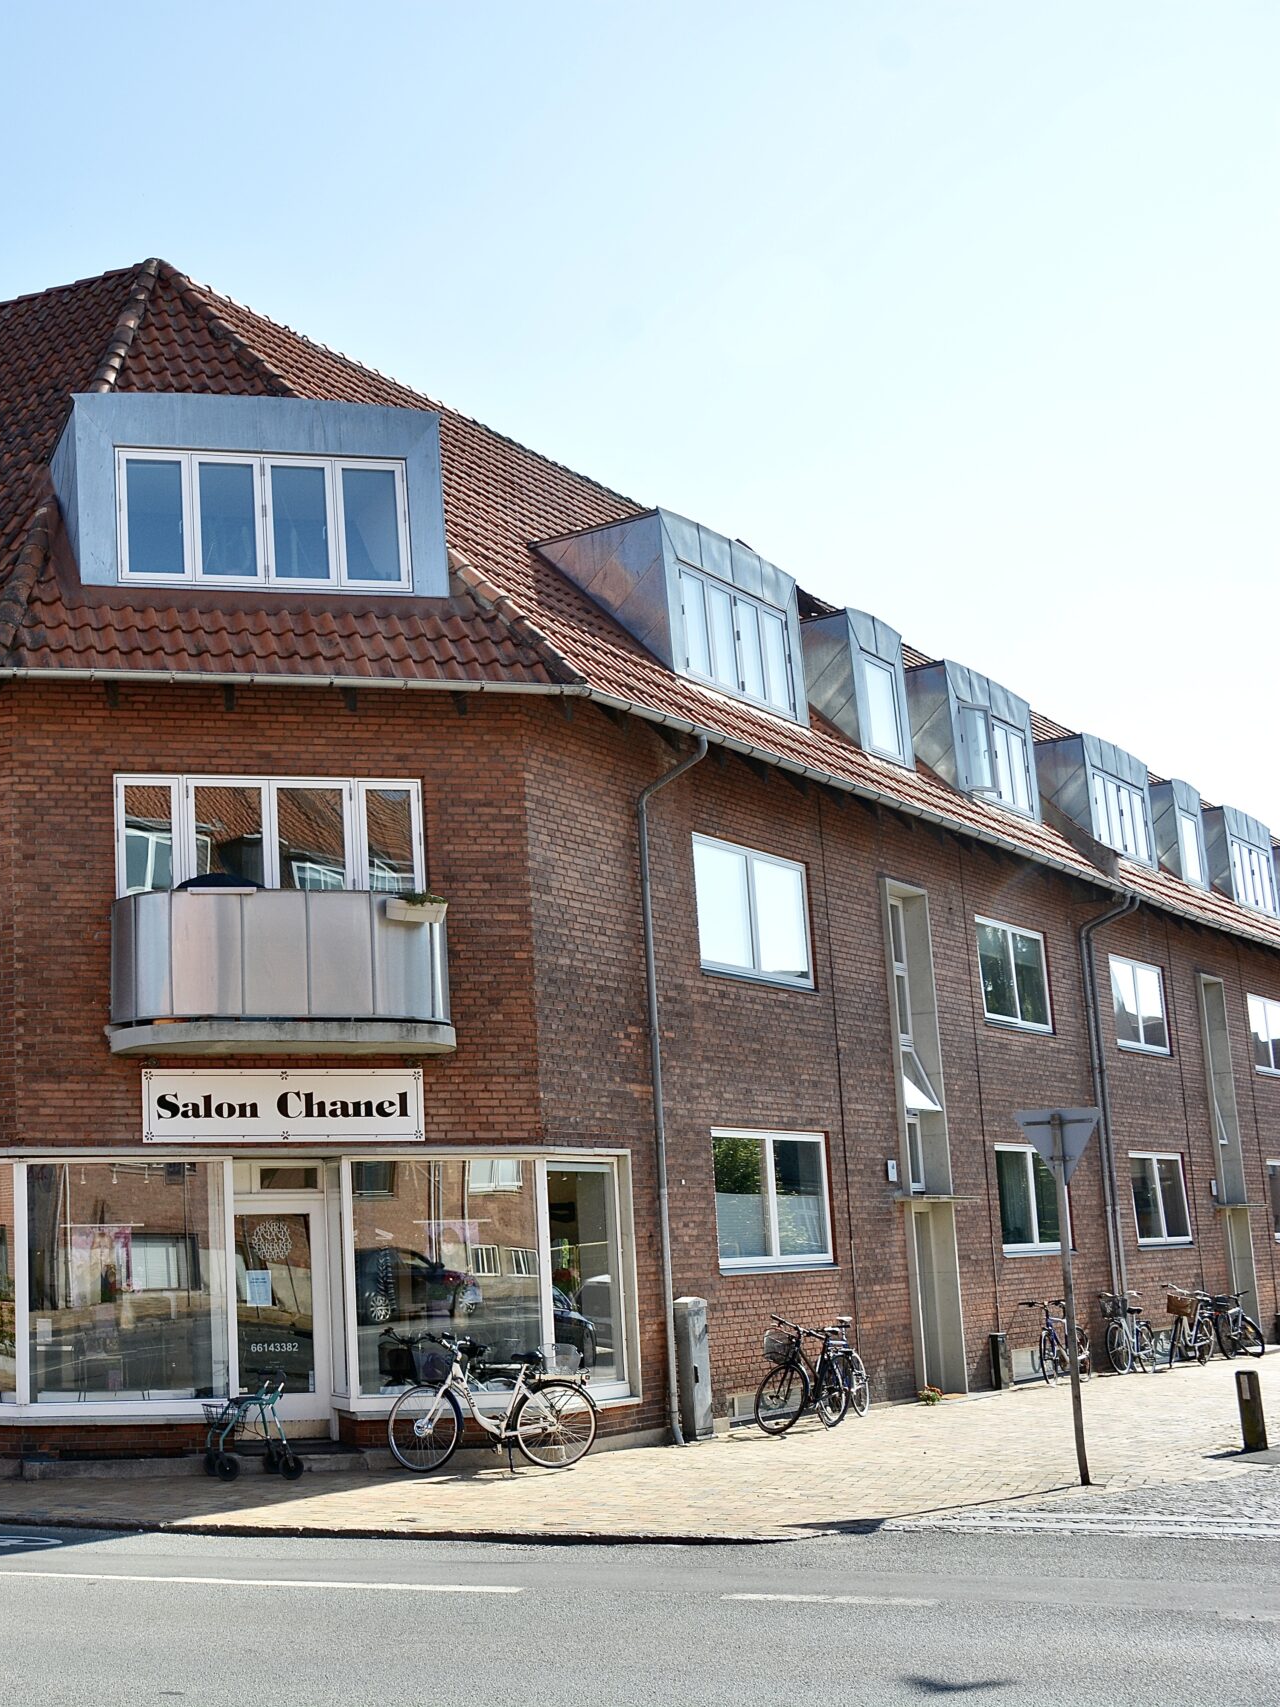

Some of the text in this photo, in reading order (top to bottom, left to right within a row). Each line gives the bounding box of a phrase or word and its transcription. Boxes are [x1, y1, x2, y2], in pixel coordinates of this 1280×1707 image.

[156, 1090, 410, 1121] Salon Chanel
[250, 1342, 299, 1353] 66143382
